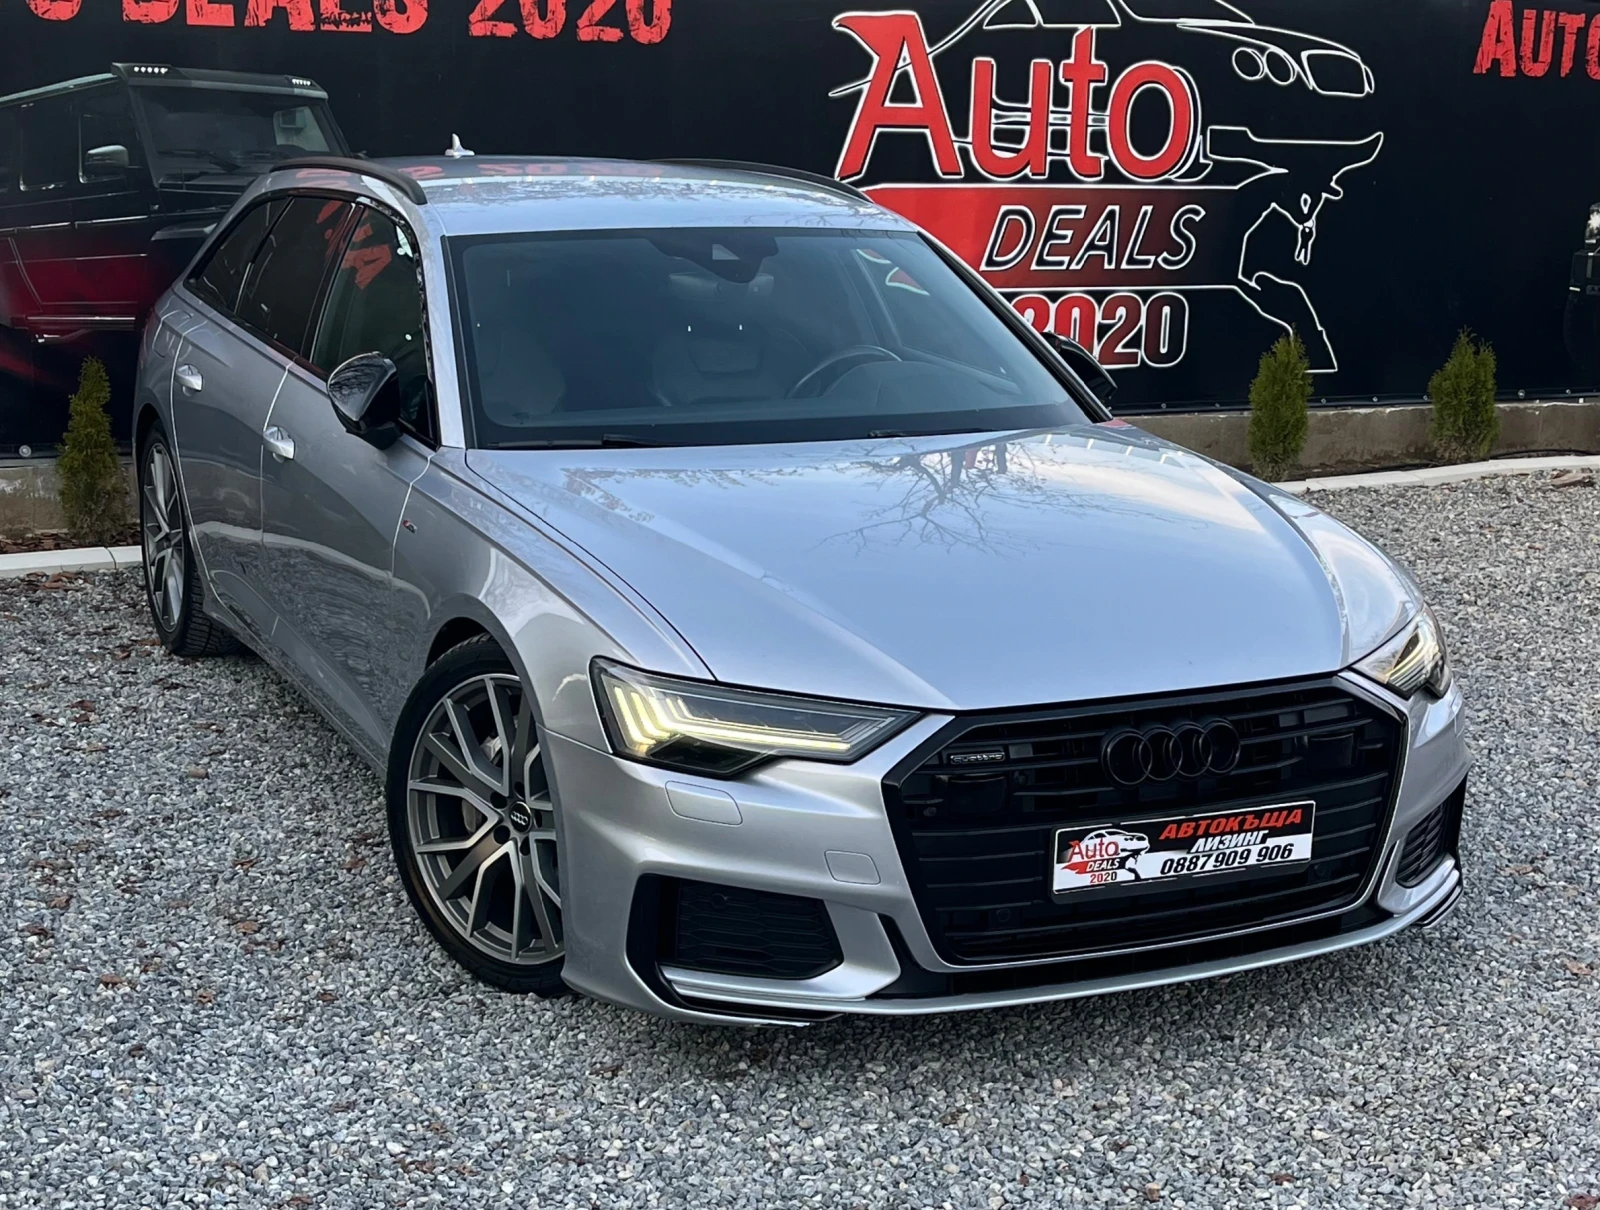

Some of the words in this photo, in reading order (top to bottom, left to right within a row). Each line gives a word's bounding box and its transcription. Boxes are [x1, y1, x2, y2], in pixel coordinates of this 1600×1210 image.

[832, 11, 1192, 182] Auto
[980, 204, 1205, 271] DEALS
[1159, 809, 1302, 840] АВТОКЪЩА
[1068, 837, 1120, 862] Auto
[1190, 830, 1269, 853] ЛИЗИНГ
[1086, 859, 1120, 872] DEALS
[1160, 853, 1213, 876] 0887
[1212, 848, 1251, 868] 909
[1256, 843, 1294, 862] 906
[1090, 871, 1117, 883] 2020
